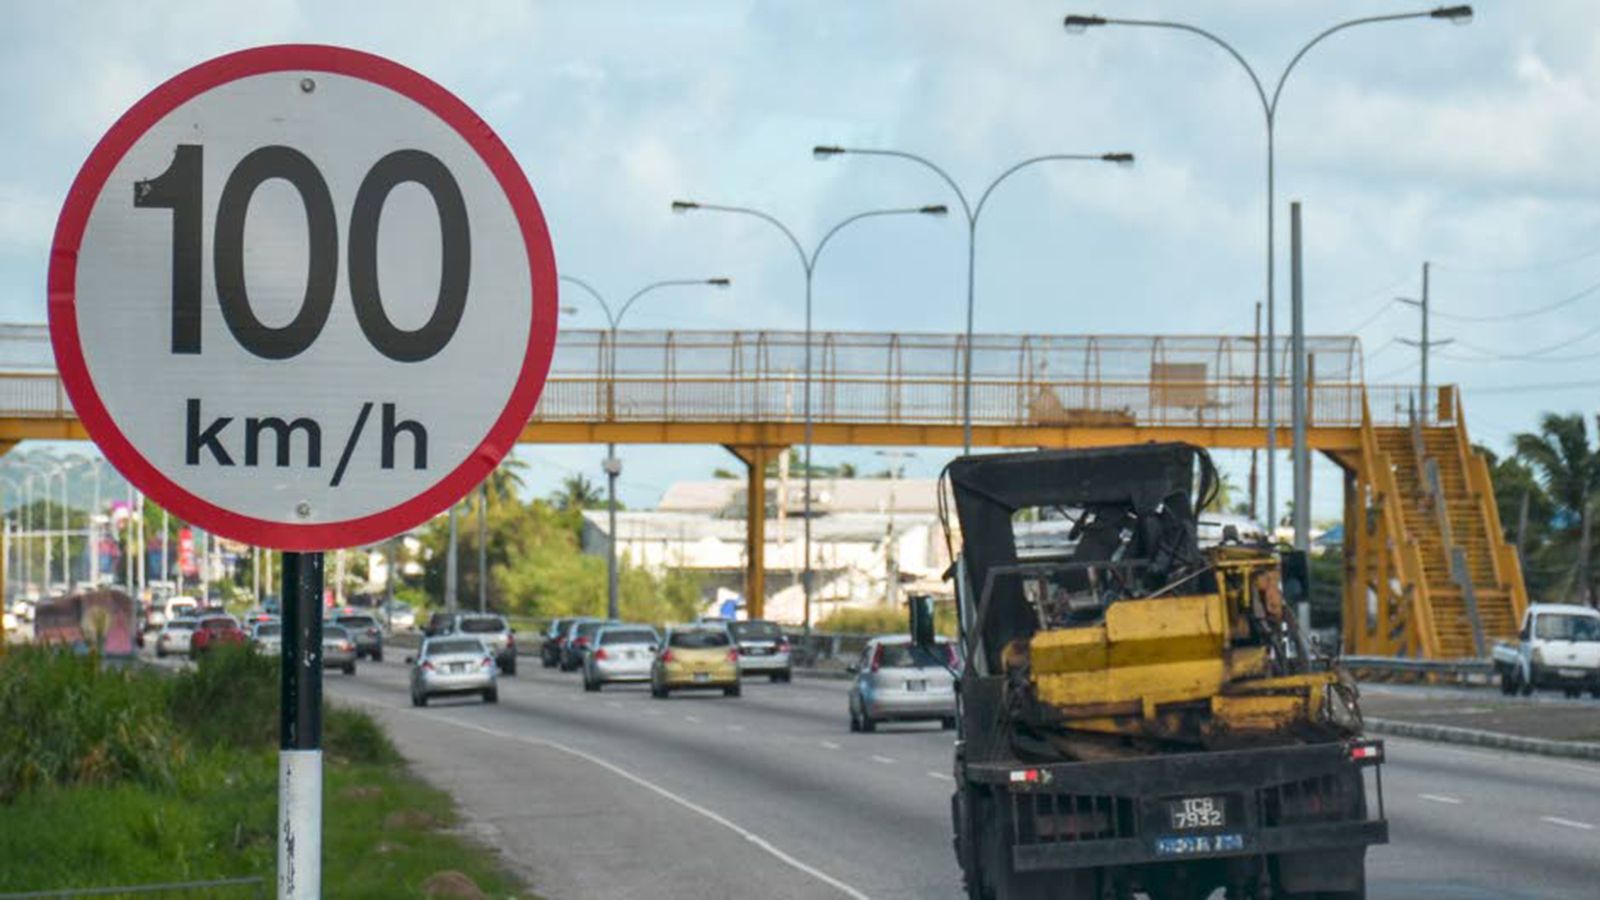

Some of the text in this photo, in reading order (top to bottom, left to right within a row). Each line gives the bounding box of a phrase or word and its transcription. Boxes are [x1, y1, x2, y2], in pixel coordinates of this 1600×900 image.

[134, 144, 471, 363] 100
[185, 398, 428, 487] km/h
[1175, 811, 1221, 828] 7932
[1182, 797, 1213, 814] TCB
